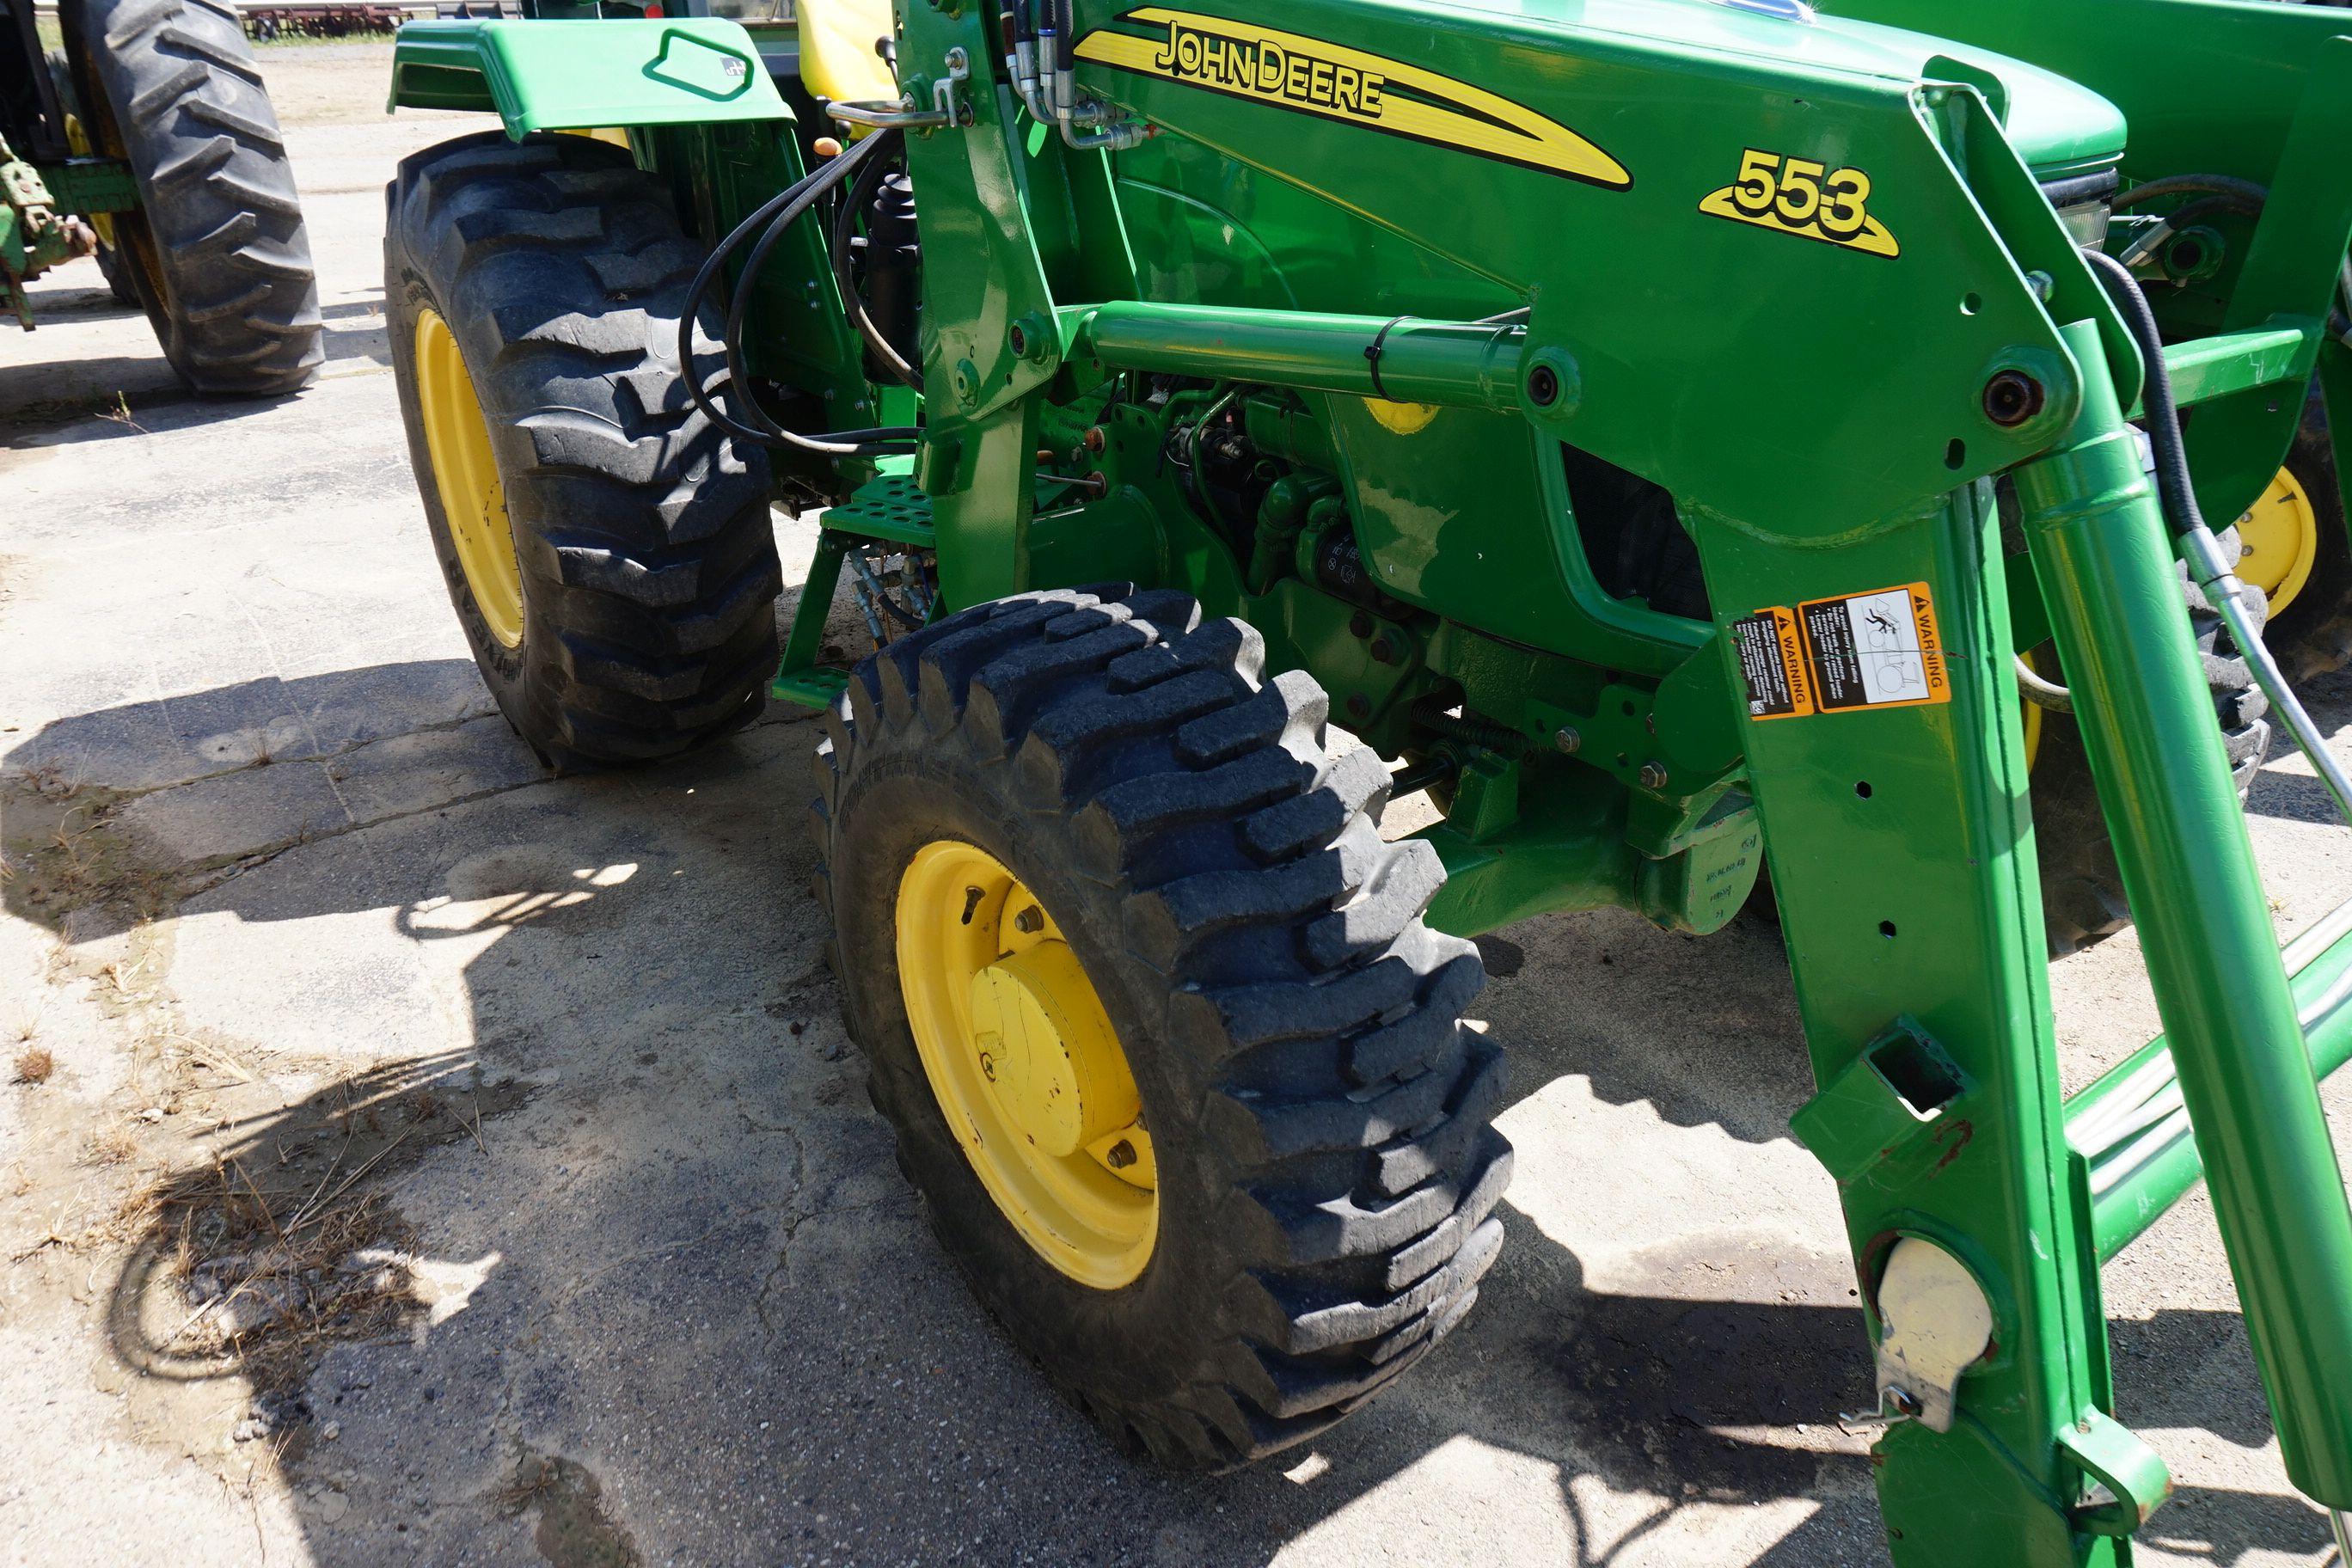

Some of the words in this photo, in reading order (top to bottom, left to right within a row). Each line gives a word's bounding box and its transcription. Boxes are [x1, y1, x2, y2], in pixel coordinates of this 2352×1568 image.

[1732, 147, 1872, 242] 553
[1761, 621, 1770, 646] engaging
[1767, 646, 1778, 677] attachment
[1815, 615, 1823, 633] Lower
[1824, 661, 1834, 682] ground
[1827, 612, 1833, 622] Do
[1835, 657, 1845, 680] perform
[1840, 615, 1848, 631] avoid
[1920, 615, 1942, 688] WARNING
[1752, 646, 1762, 675] attachment
[1759, 676, 1768, 702] detaching
[1767, 620, 1773, 629] DO
[1772, 643, 1780, 664] operate
[1780, 683, 1789, 703] without
[1784, 636, 1805, 703] WARNING
[1831, 660, 1840, 678] raised
